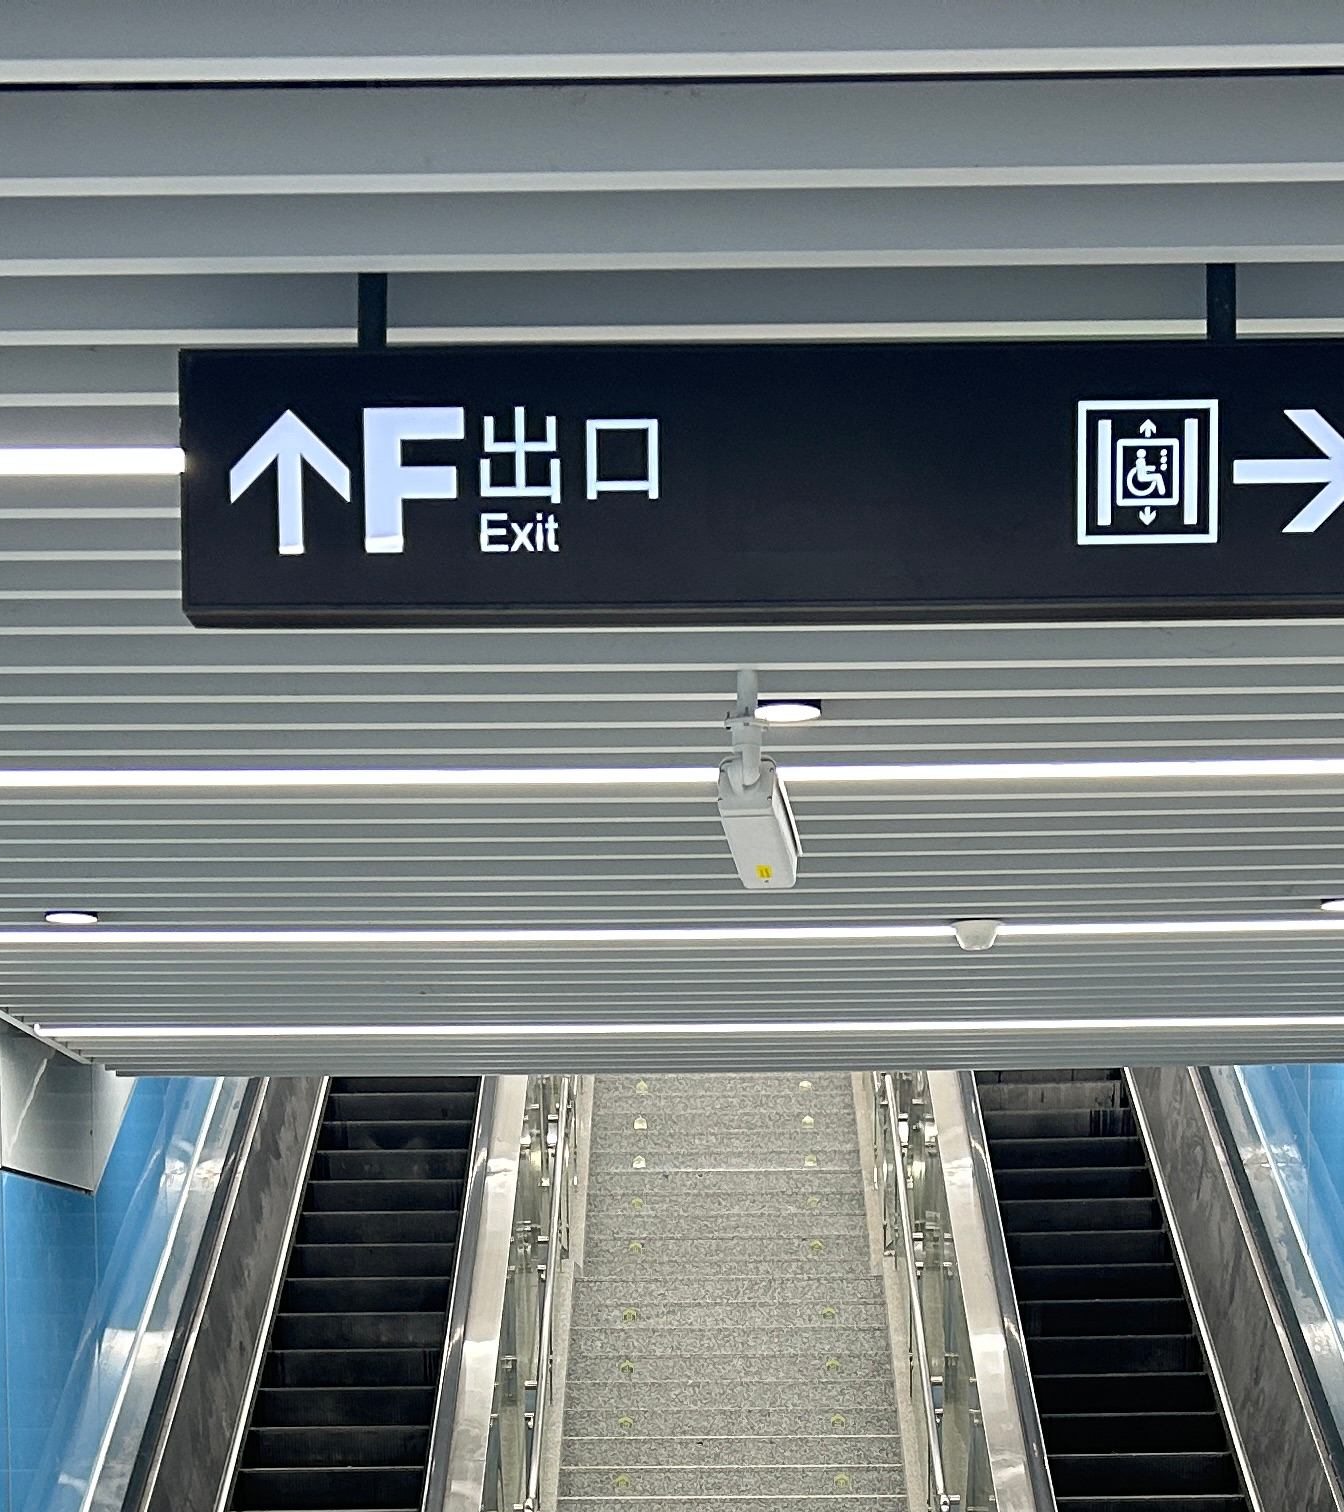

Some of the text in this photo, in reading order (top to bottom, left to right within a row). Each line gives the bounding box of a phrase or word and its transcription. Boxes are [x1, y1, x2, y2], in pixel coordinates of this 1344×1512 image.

[363, 406, 659, 553] F 出口
[480, 512, 560, 552] Exit
